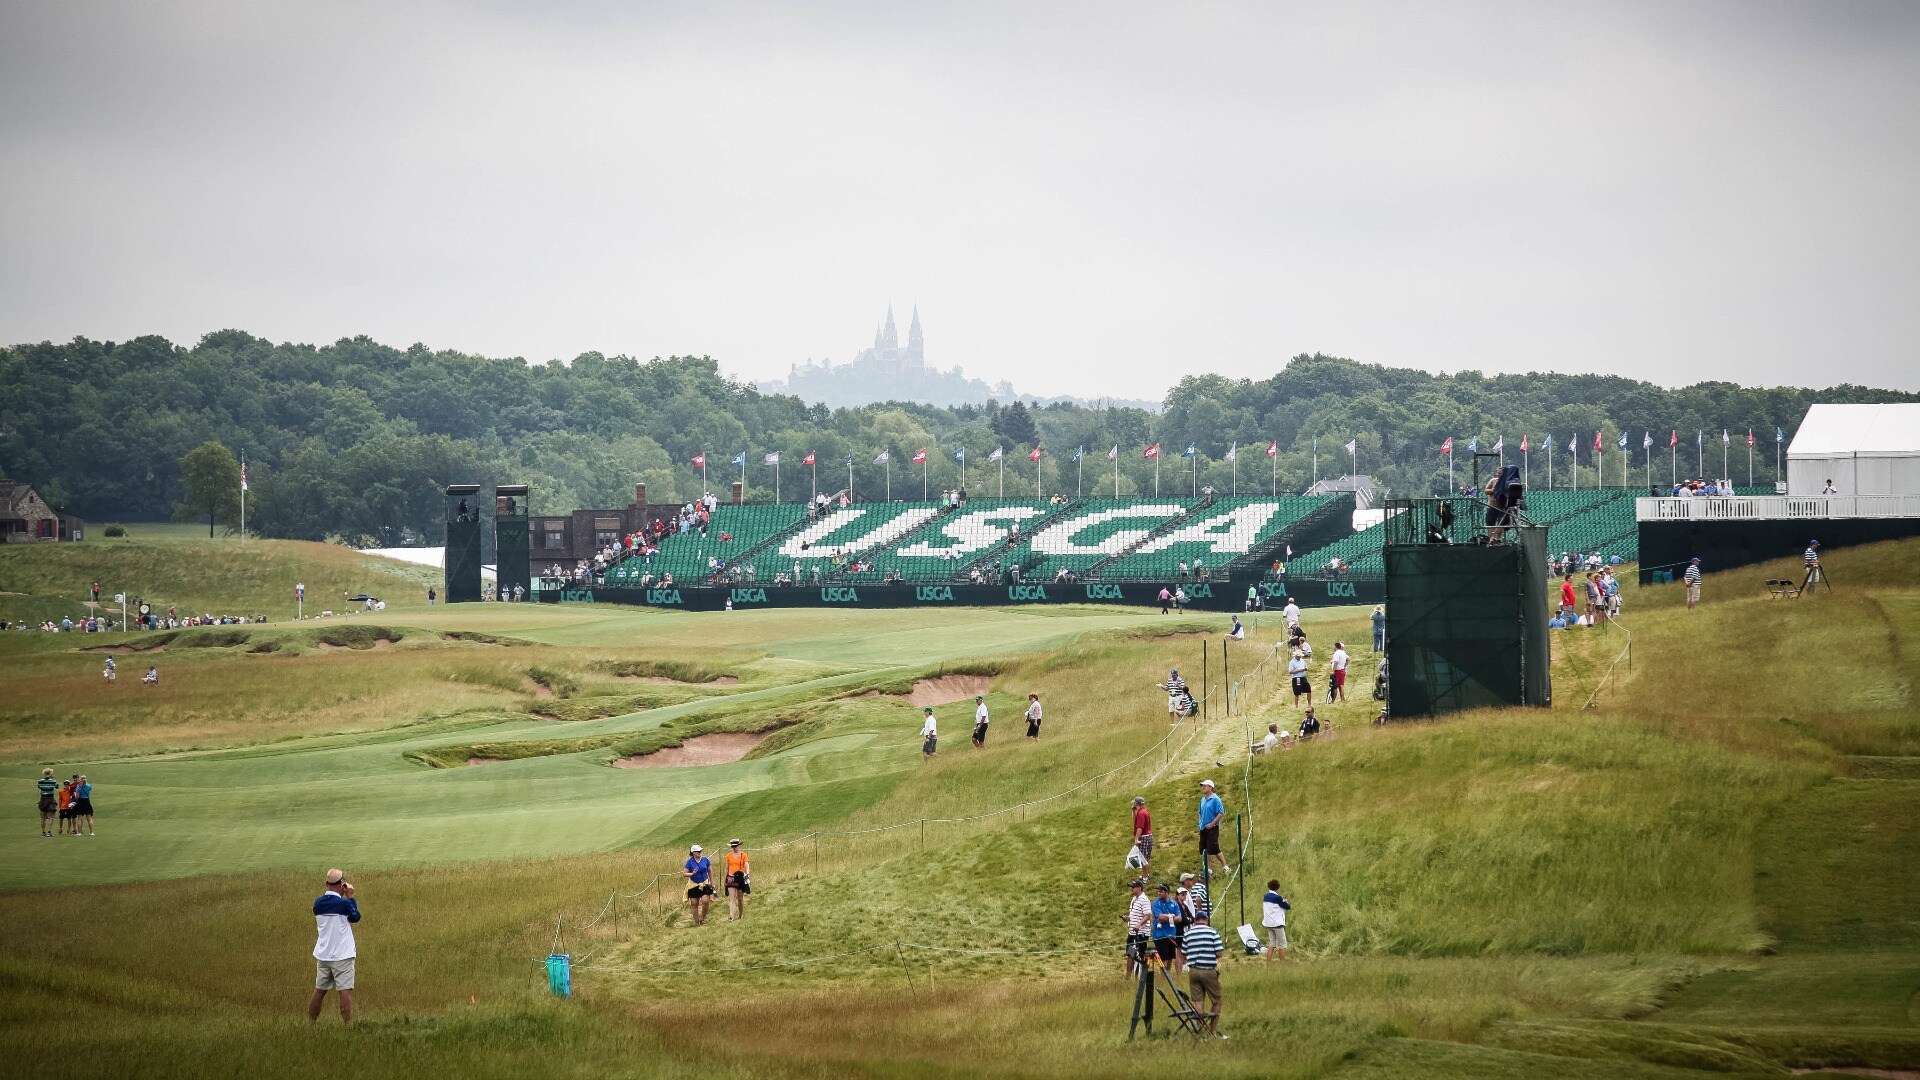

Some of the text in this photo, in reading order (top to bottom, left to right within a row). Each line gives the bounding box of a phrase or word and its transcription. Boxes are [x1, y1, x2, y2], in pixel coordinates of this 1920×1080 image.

[778, 503, 1280, 558] USGA
[560, 590, 595, 603] USGA
[646, 589, 682, 604] USGA
[731, 588, 767, 603] USGA
[821, 587, 858, 602] USGA
[916, 586, 953, 600] USGA
[1008, 584, 1046, 600] USGA
[1086, 584, 1122, 599] USGA
[1263, 582, 1287, 597] SGA
[1327, 582, 1356, 597] USGA
